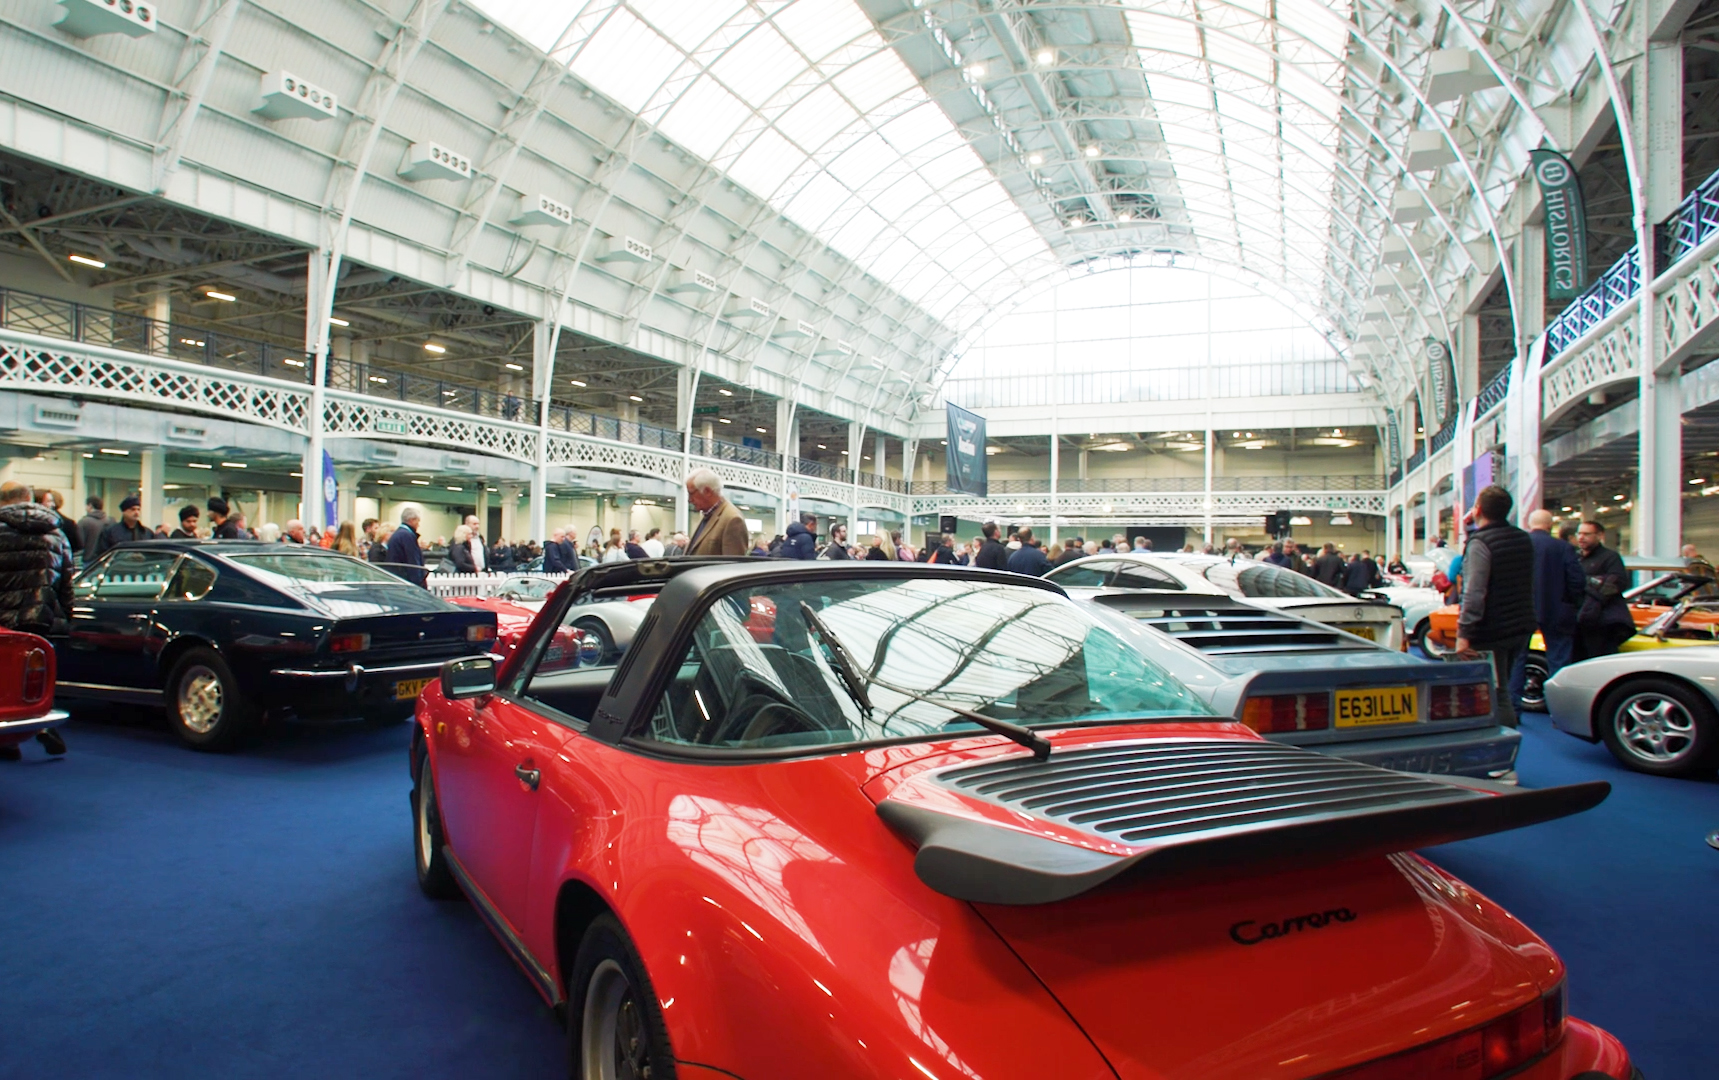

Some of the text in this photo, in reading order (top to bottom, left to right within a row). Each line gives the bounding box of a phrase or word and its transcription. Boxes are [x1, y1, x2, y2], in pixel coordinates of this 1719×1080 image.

[398, 680, 418, 696] GKV
[1339, 693, 1412, 719] E631LLN
[1229, 907, 1357, 945] Carrera
